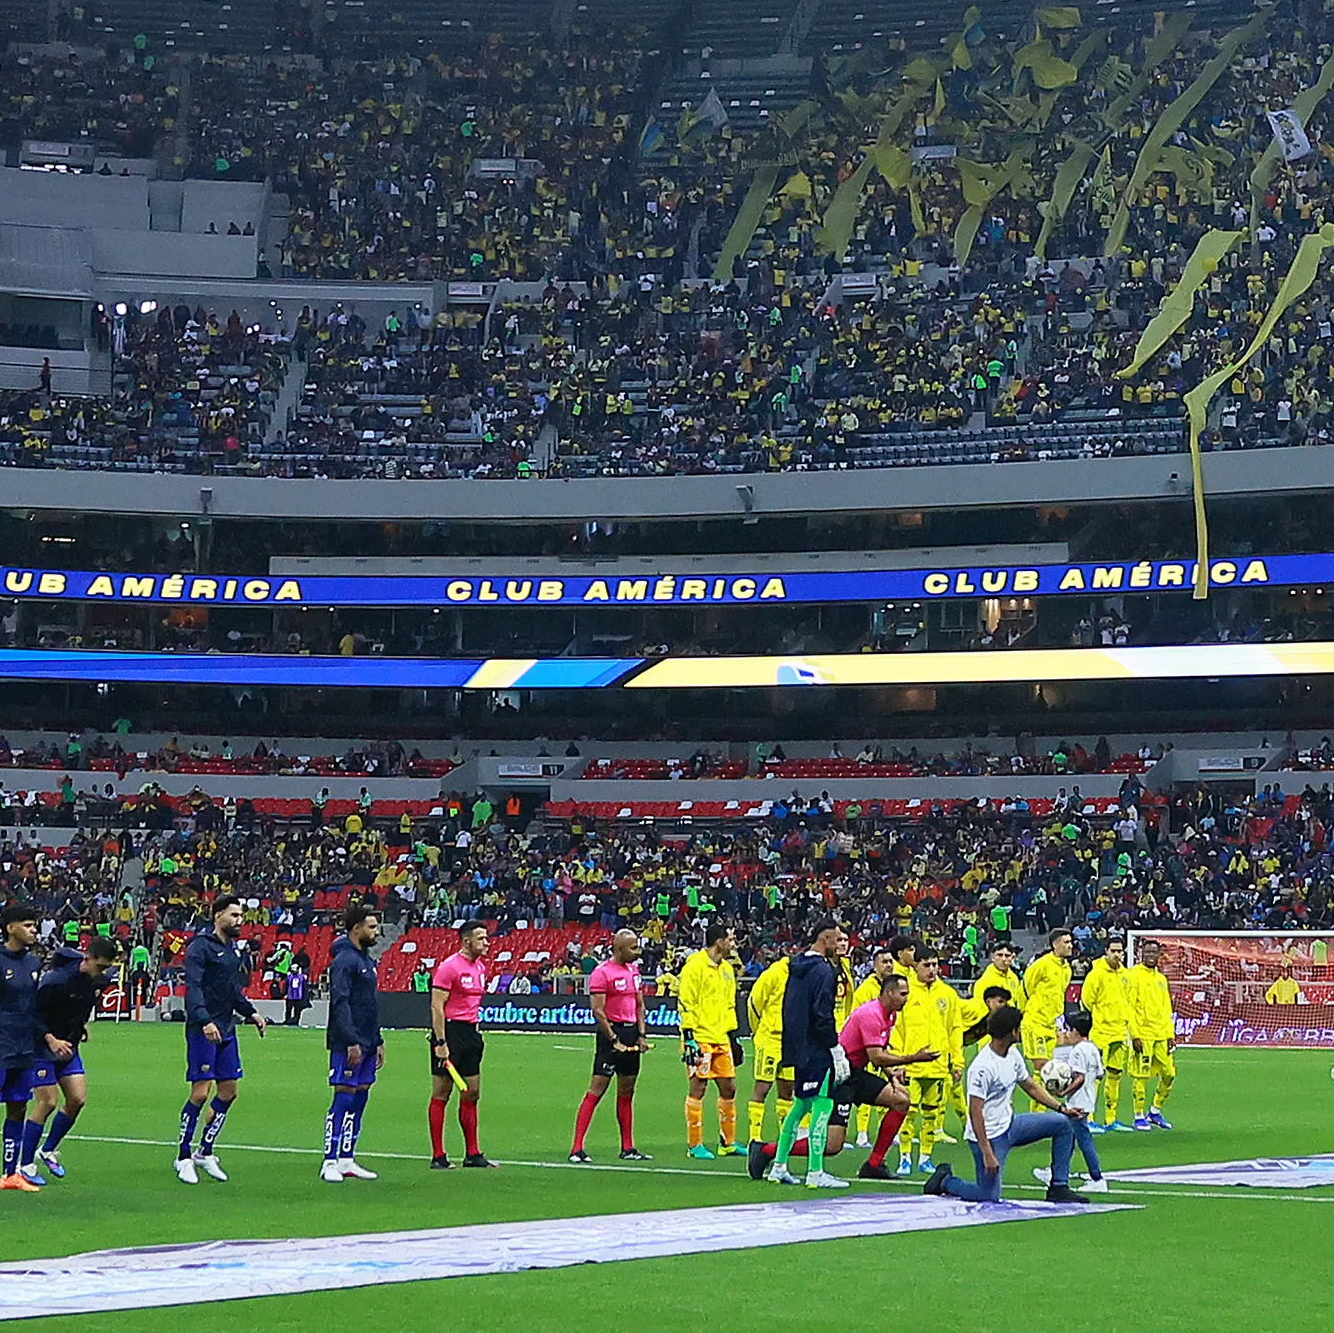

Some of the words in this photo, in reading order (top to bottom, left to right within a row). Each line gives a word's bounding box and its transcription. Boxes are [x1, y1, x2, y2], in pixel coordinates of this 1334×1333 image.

[87, 574, 301, 600] AMÉRICA
[447, 581, 564, 601] CLUB
[583, 575, 785, 600] AMÉRICA
[924, 570, 1038, 594] CLUB
[477, 1002, 537, 1024] scubre
[342, 1111, 356, 1152] CREST
